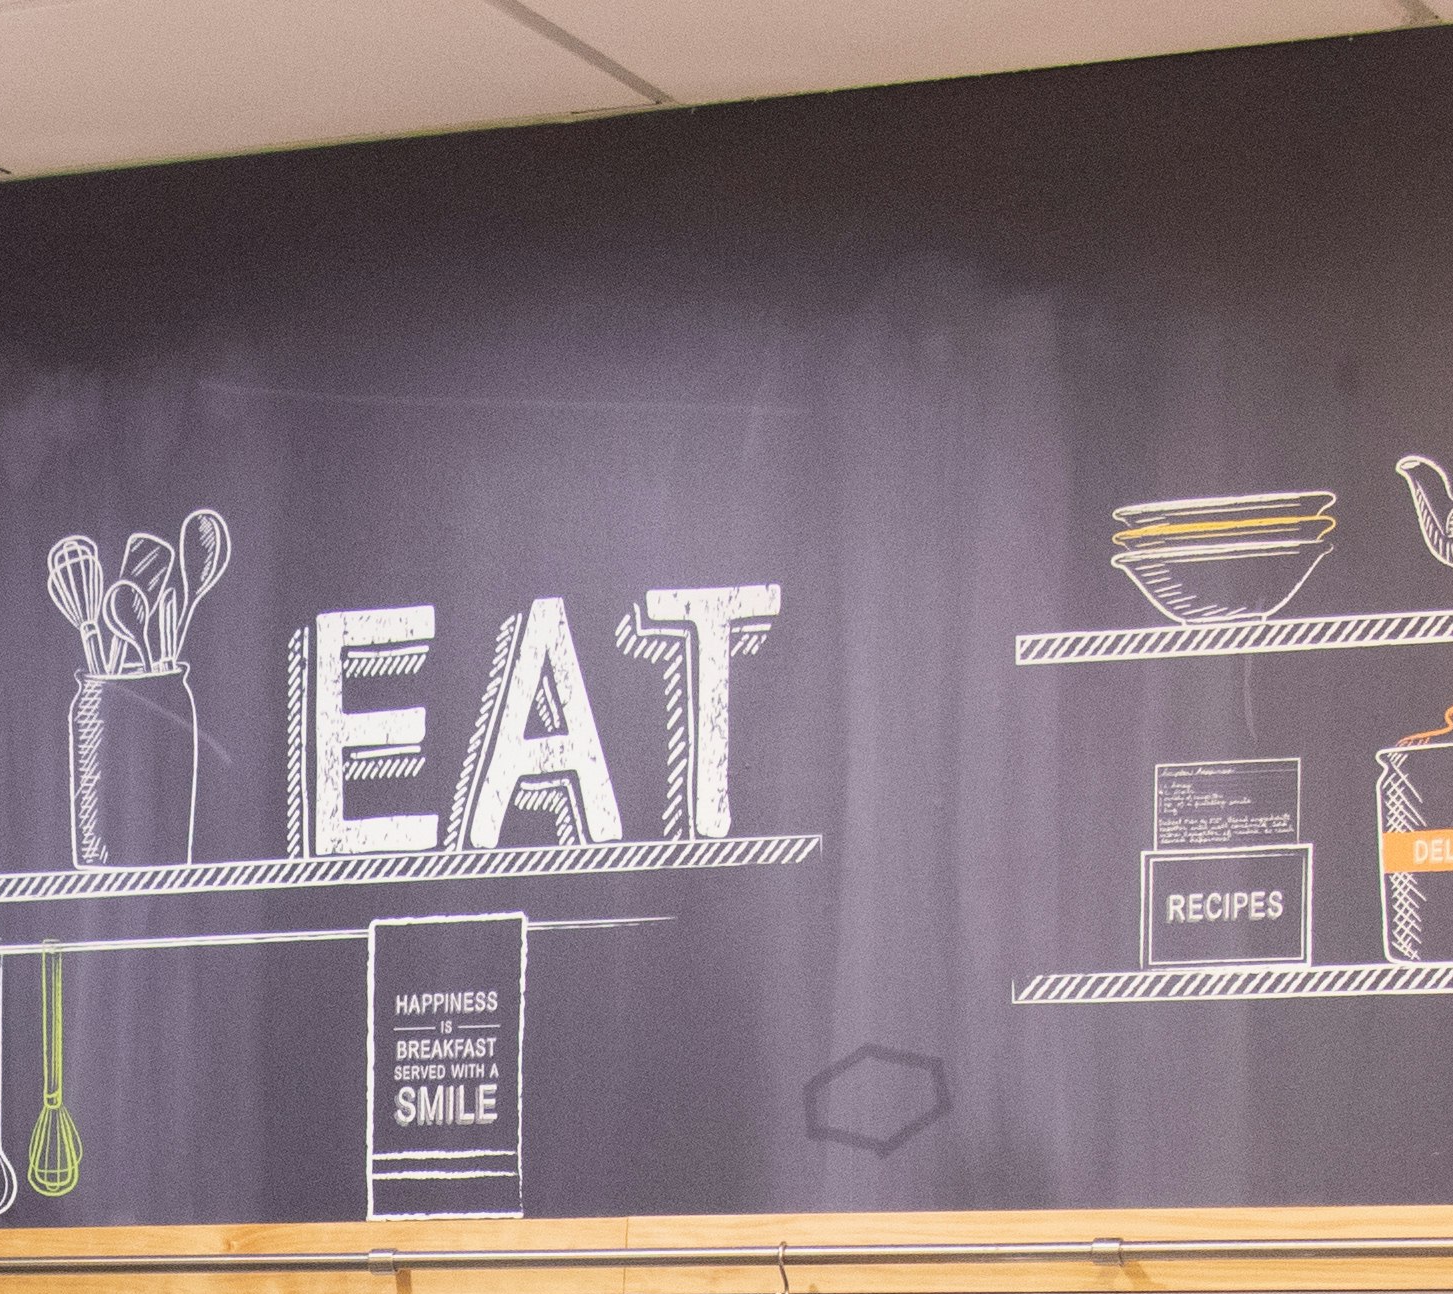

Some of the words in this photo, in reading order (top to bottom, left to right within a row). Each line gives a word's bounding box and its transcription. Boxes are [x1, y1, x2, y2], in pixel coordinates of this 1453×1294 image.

[289, 584, 781, 857] EAT
[1167, 891, 1284, 923] RECIPES
[395, 991, 499, 1015] HAPPINESS
[440, 1020, 453, 1034] IS
[396, 1037, 497, 1060] BREAKFAST
[394, 1064, 446, 1081] SERVED
[451, 1063, 485, 1079] WITH
[489, 1063, 499, 1078] A
[394, 1084, 498, 1127] SMILE
